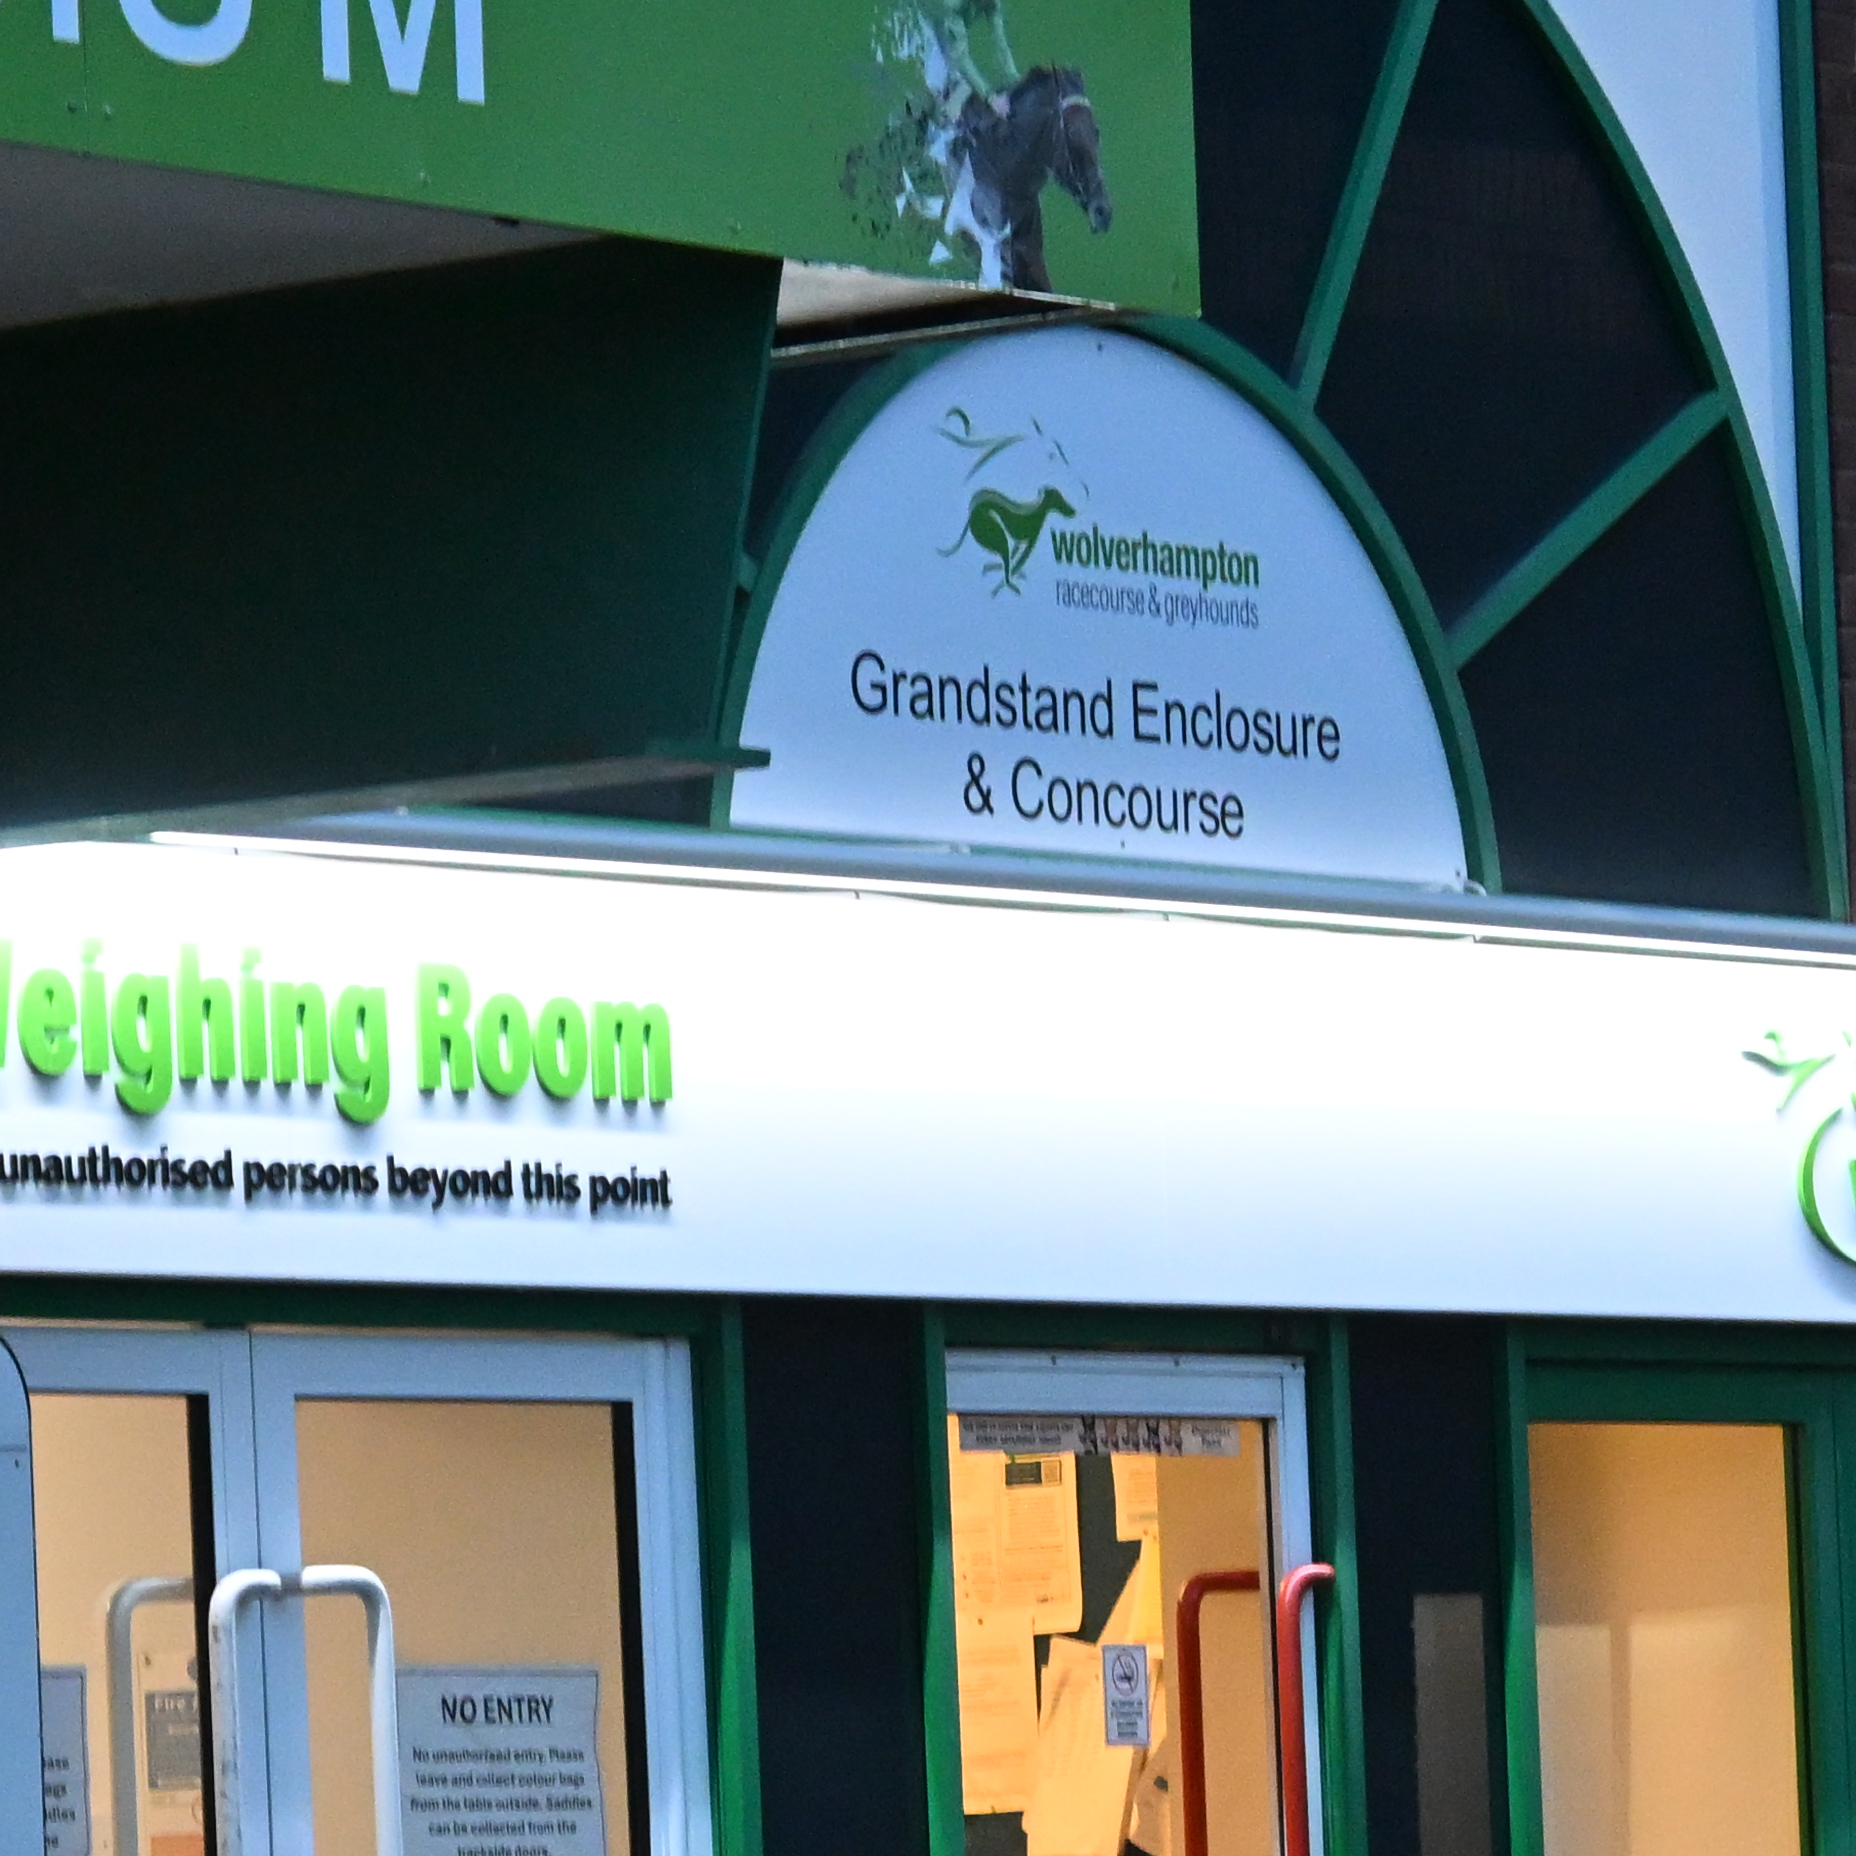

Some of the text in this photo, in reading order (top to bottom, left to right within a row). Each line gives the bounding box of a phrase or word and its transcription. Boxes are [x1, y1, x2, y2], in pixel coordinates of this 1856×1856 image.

[1050, 524, 1260, 590] wolverhampton
[1054, 578, 1260, 630] racecourse & greyhounds
[850, 649, 1341, 762] Grandstand Enclosure
[962, 752, 1245, 839] & Concourse
[416, 962, 674, 1103] Room
[243, 1157, 379, 1204] persons
[386, 1155, 514, 1211] beyond
[521, 1161, 581, 1202] this
[589, 1168, 673, 1218] point
[441, 1693, 554, 1725] NO ENTRY
[443, 1798, 461, 1812] the
[451, 1773, 473, 1788] and
[558, 1820, 577, 1836] the
